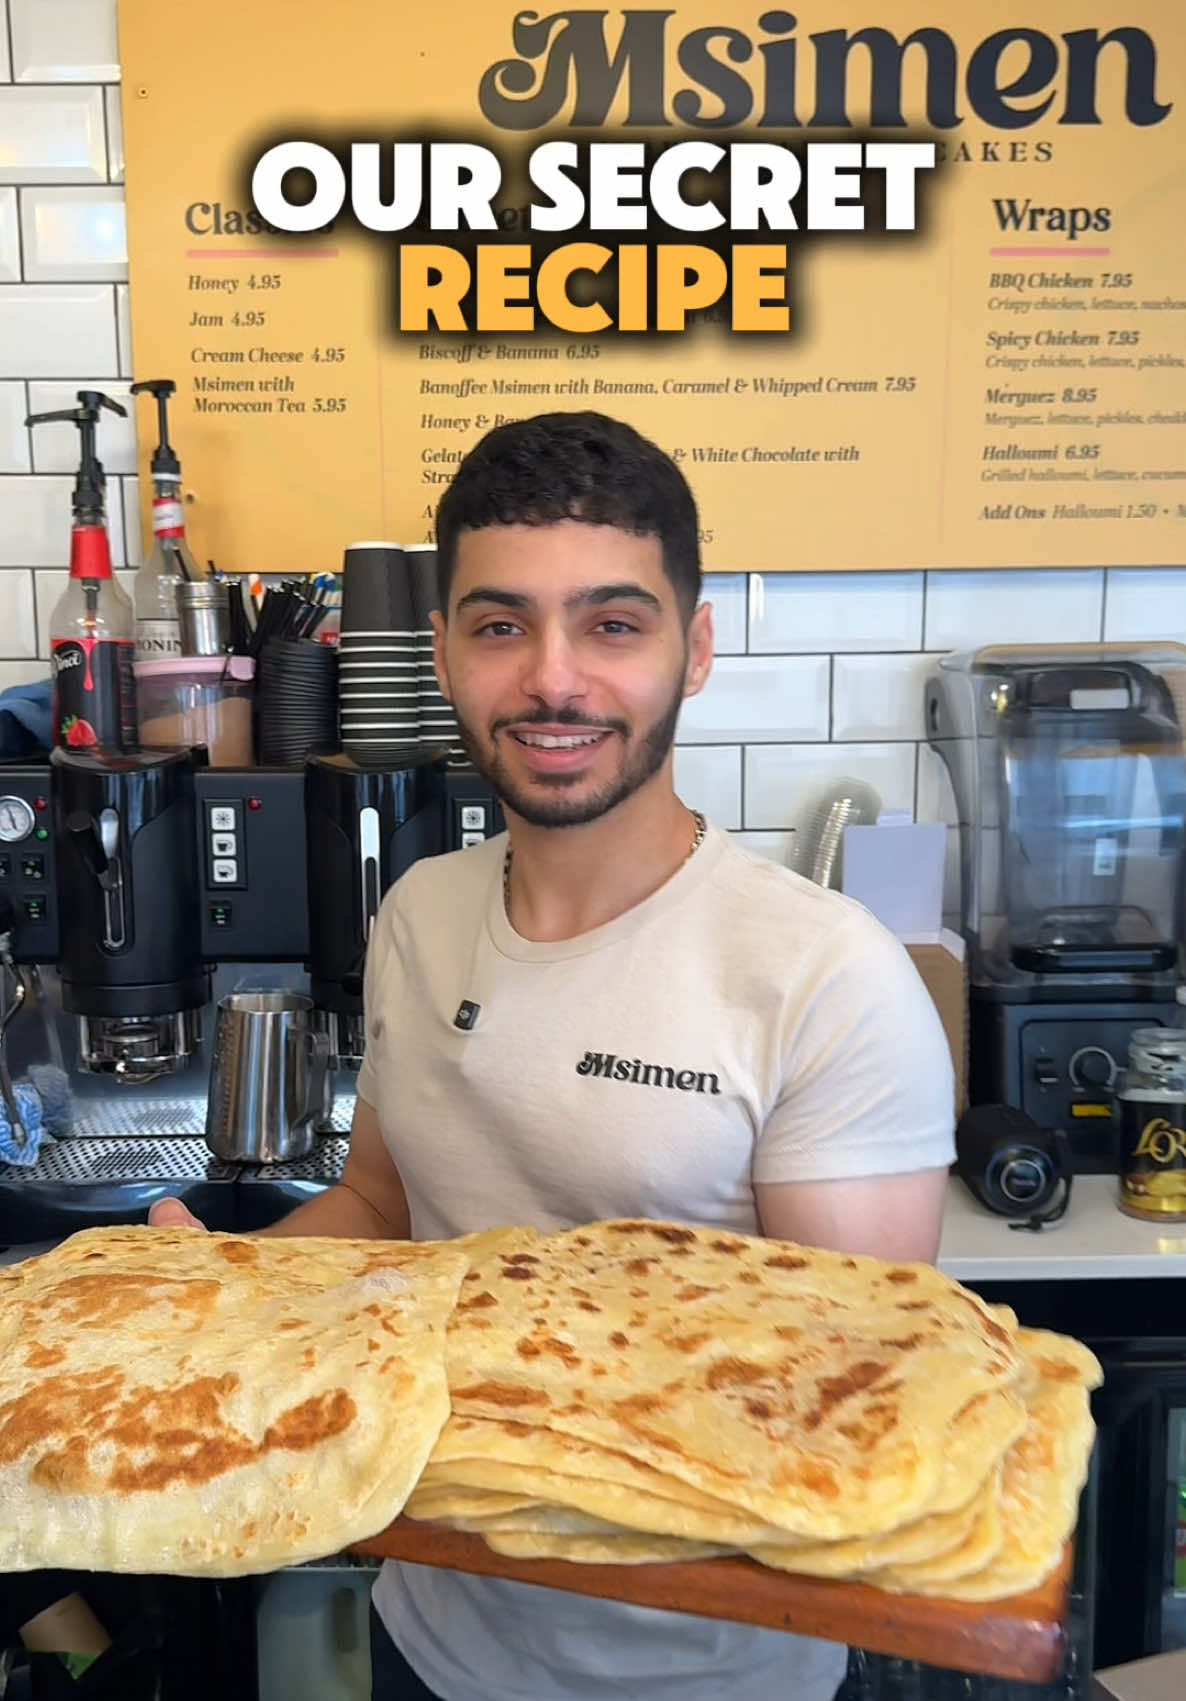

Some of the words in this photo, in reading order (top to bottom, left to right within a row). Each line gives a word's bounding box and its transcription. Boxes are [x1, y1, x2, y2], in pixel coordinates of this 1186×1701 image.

[479, 10, 1173, 131] Msimen
[993, 199, 1111, 239] Wraps
[188, 274, 239, 294] Honey
[248, 274, 282, 290] 4.95
[989, 273, 1025, 292] BBQ
[1028, 272, 1094, 289] Chicken
[1101, 273, 1133, 288] 7.95
[189, 311, 224, 327] Jam
[231, 311, 265, 327] 4.95
[986, 331, 1031, 350] Spicy
[1035, 329, 1100, 346] Chicken
[1107, 330, 1140, 346] 7.95
[191, 348, 244, 363] Cream
[248, 347, 304, 363] Cheese
[311, 347, 345, 363] 4.95
[419, 345, 474, 363] Biscoff
[477, 345, 492, 360] &
[496, 345, 559, 360] Banana
[566, 344, 600, 360] 6.95
[193, 376, 254, 392] Msimen
[258, 375, 295, 392] with
[420, 379, 487, 397] Banoffee
[491, 379, 550, 394] Msimen
[554, 379, 589, 394] with
[662, 378, 730, 394] Caramel
[734, 378, 748, 393] &
[753, 377, 825, 397] Whipped
[826, 377, 878, 393] Cream
[884, 377, 917, 392] 7.95
[1062, 387, 1097, 403] 8.95
[193, 397, 273, 413] Moroccan
[277, 397, 306, 413] Tea
[312, 397, 347, 413] 5.95
[421, 414, 471, 433] Honey
[475, 414, 490, 429] &
[421, 448, 465, 463] Gelat
[692, 447, 739, 463] White
[741, 446, 820, 463] Chocolate
[824, 446, 860, 462] with
[982, 444, 1059, 461] Halloumi
[1065, 444, 1100, 460] 6.95
[981, 505, 1012, 520] Add
[1015, 505, 1047, 519] Ons
[576, 1051, 721, 1095] Msimen
